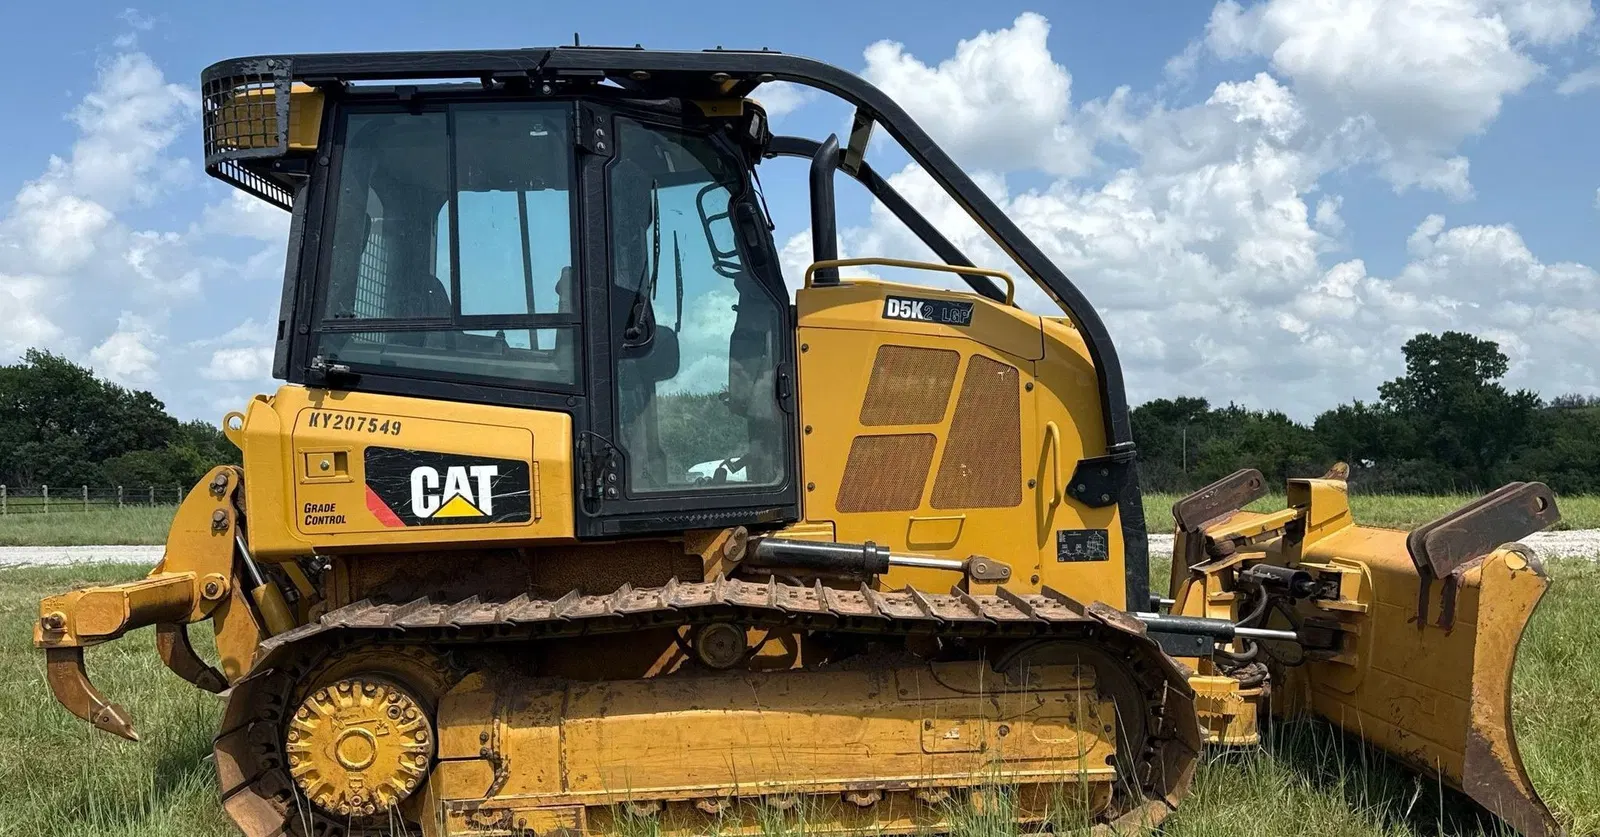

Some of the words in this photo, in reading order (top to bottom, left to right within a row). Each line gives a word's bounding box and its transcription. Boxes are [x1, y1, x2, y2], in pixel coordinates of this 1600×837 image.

[887, 298, 933, 320] D5K2
[941, 307, 970, 323] LGP
[309, 412, 401, 435] KY207549
[411, 465, 498, 518] CAT
[304, 503, 336, 513] GRADE
[305, 515, 346, 525] CONTROL
